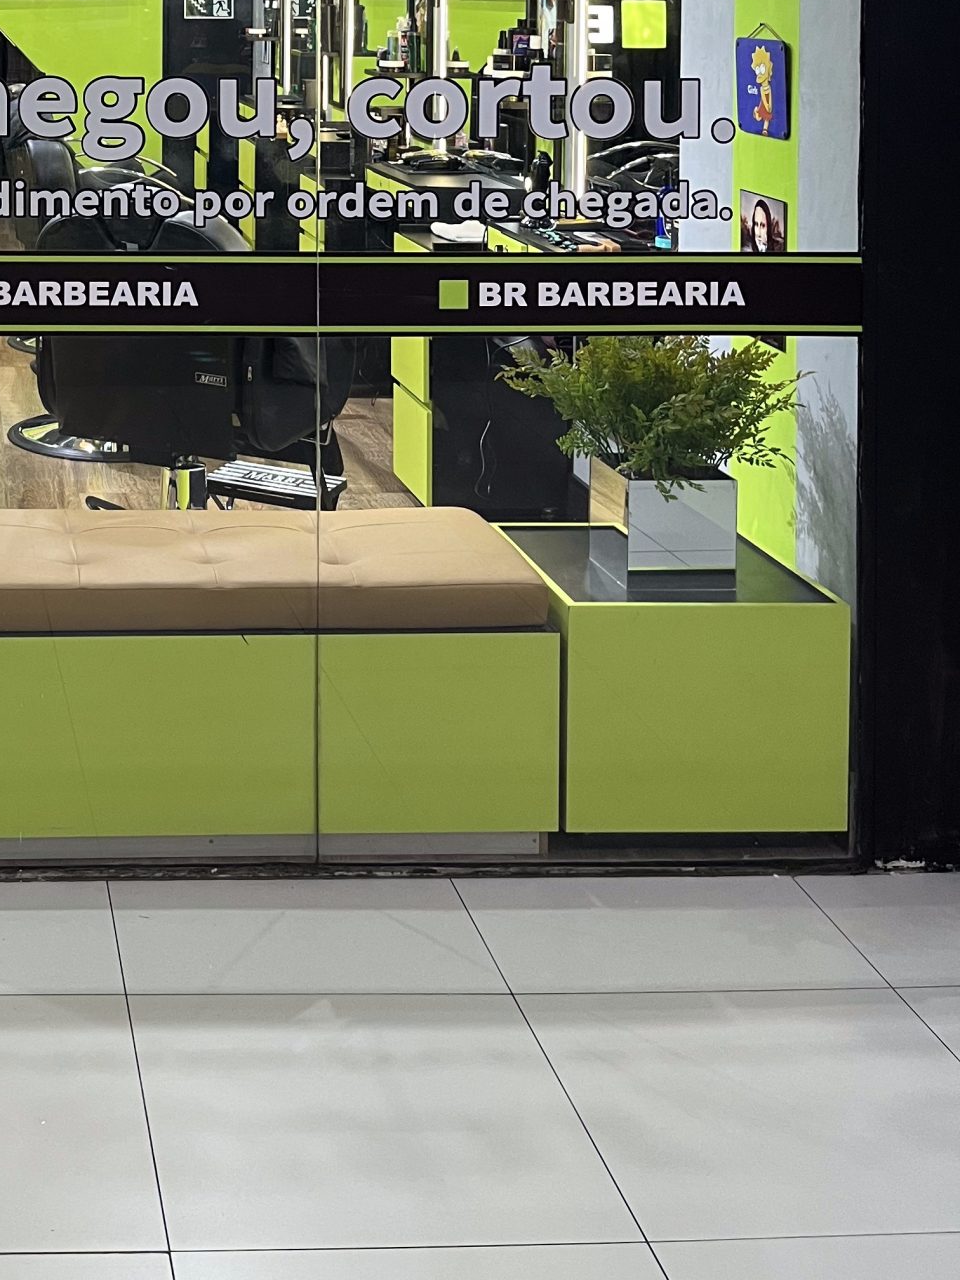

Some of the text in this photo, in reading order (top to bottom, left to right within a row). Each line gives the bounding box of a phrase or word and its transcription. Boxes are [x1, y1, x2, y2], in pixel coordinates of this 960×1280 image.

[346, 63, 737, 144] cortou.
[193, 187, 274, 227] por
[286, 179, 439, 220] ordem
[453, 180, 509, 220] de
[522, 179, 734, 229] chegada.
[478, 281, 746, 308] BR BARBEARIA
